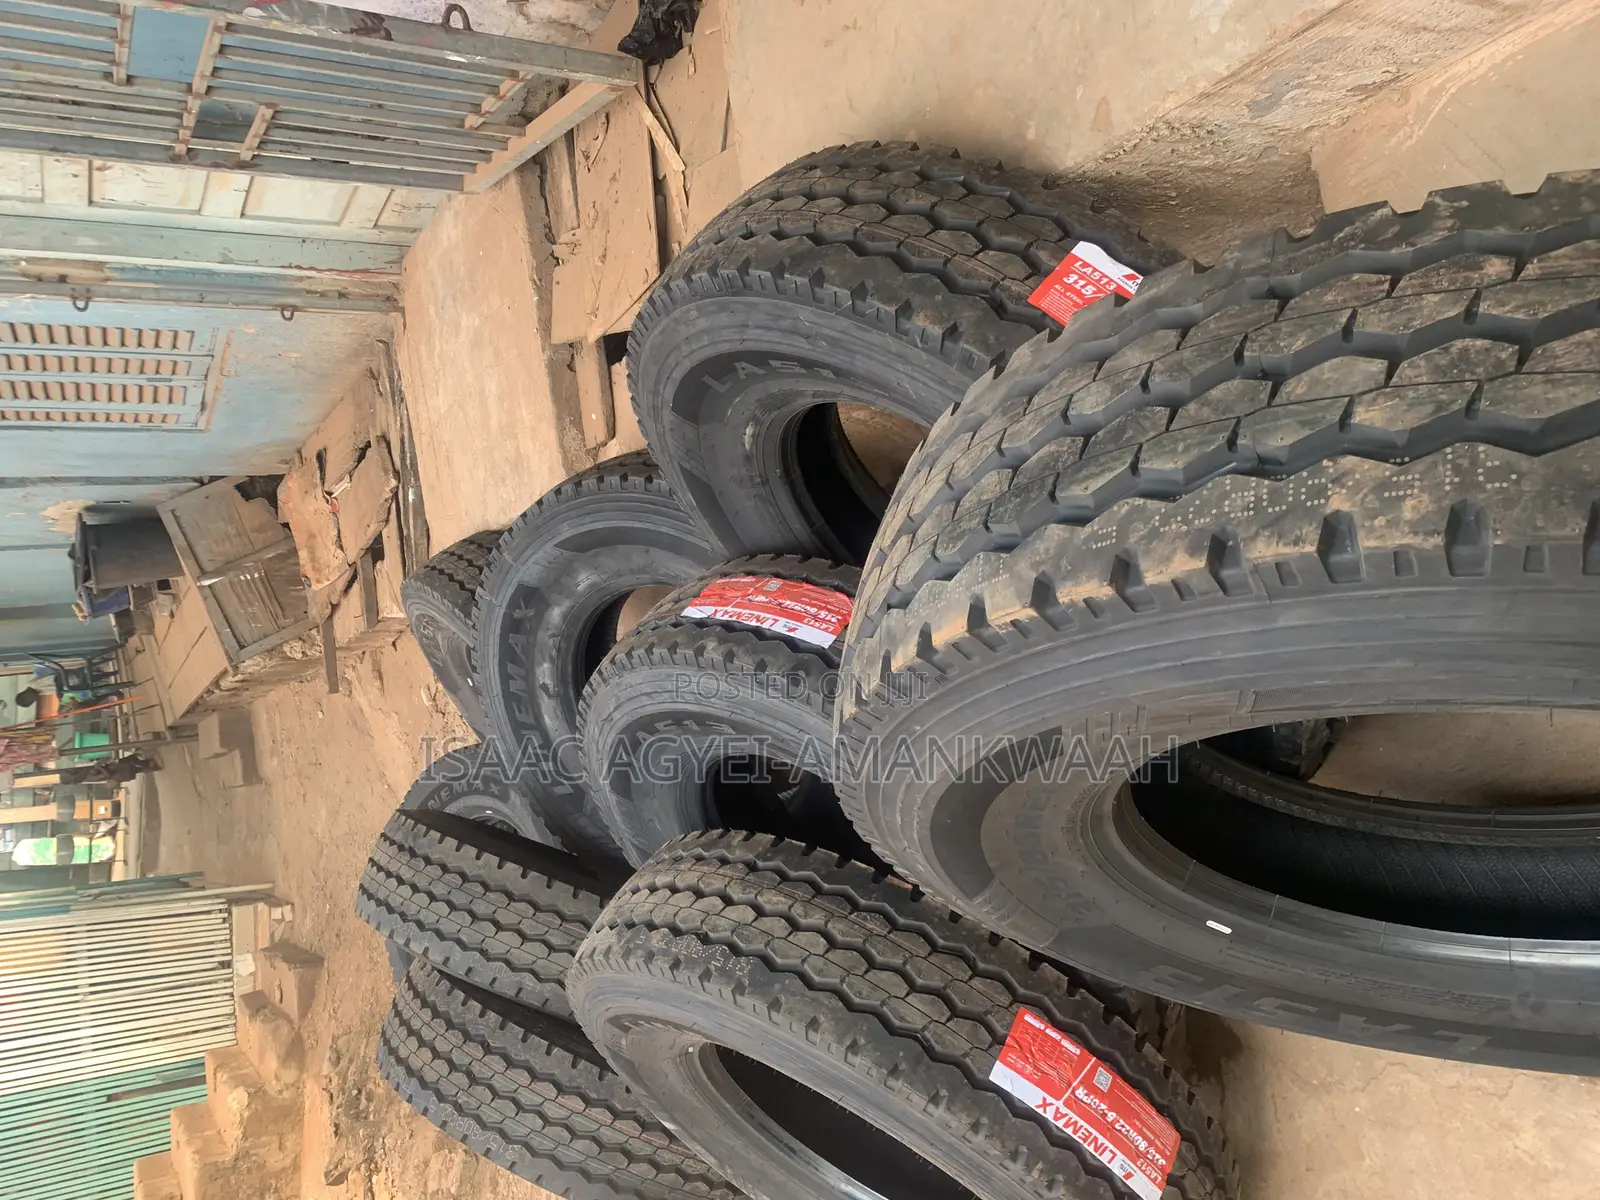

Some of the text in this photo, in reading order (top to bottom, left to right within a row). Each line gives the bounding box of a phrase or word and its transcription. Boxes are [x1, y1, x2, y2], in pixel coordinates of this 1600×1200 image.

[1073, 261, 1118, 291] LA513
[709, 607, 781, 628] LINEMAX
[803, 617, 835, 633] LA513
[1035, 1096, 1118, 1166] LINEMAX
[1136, 1157, 1162, 1184] LA513
